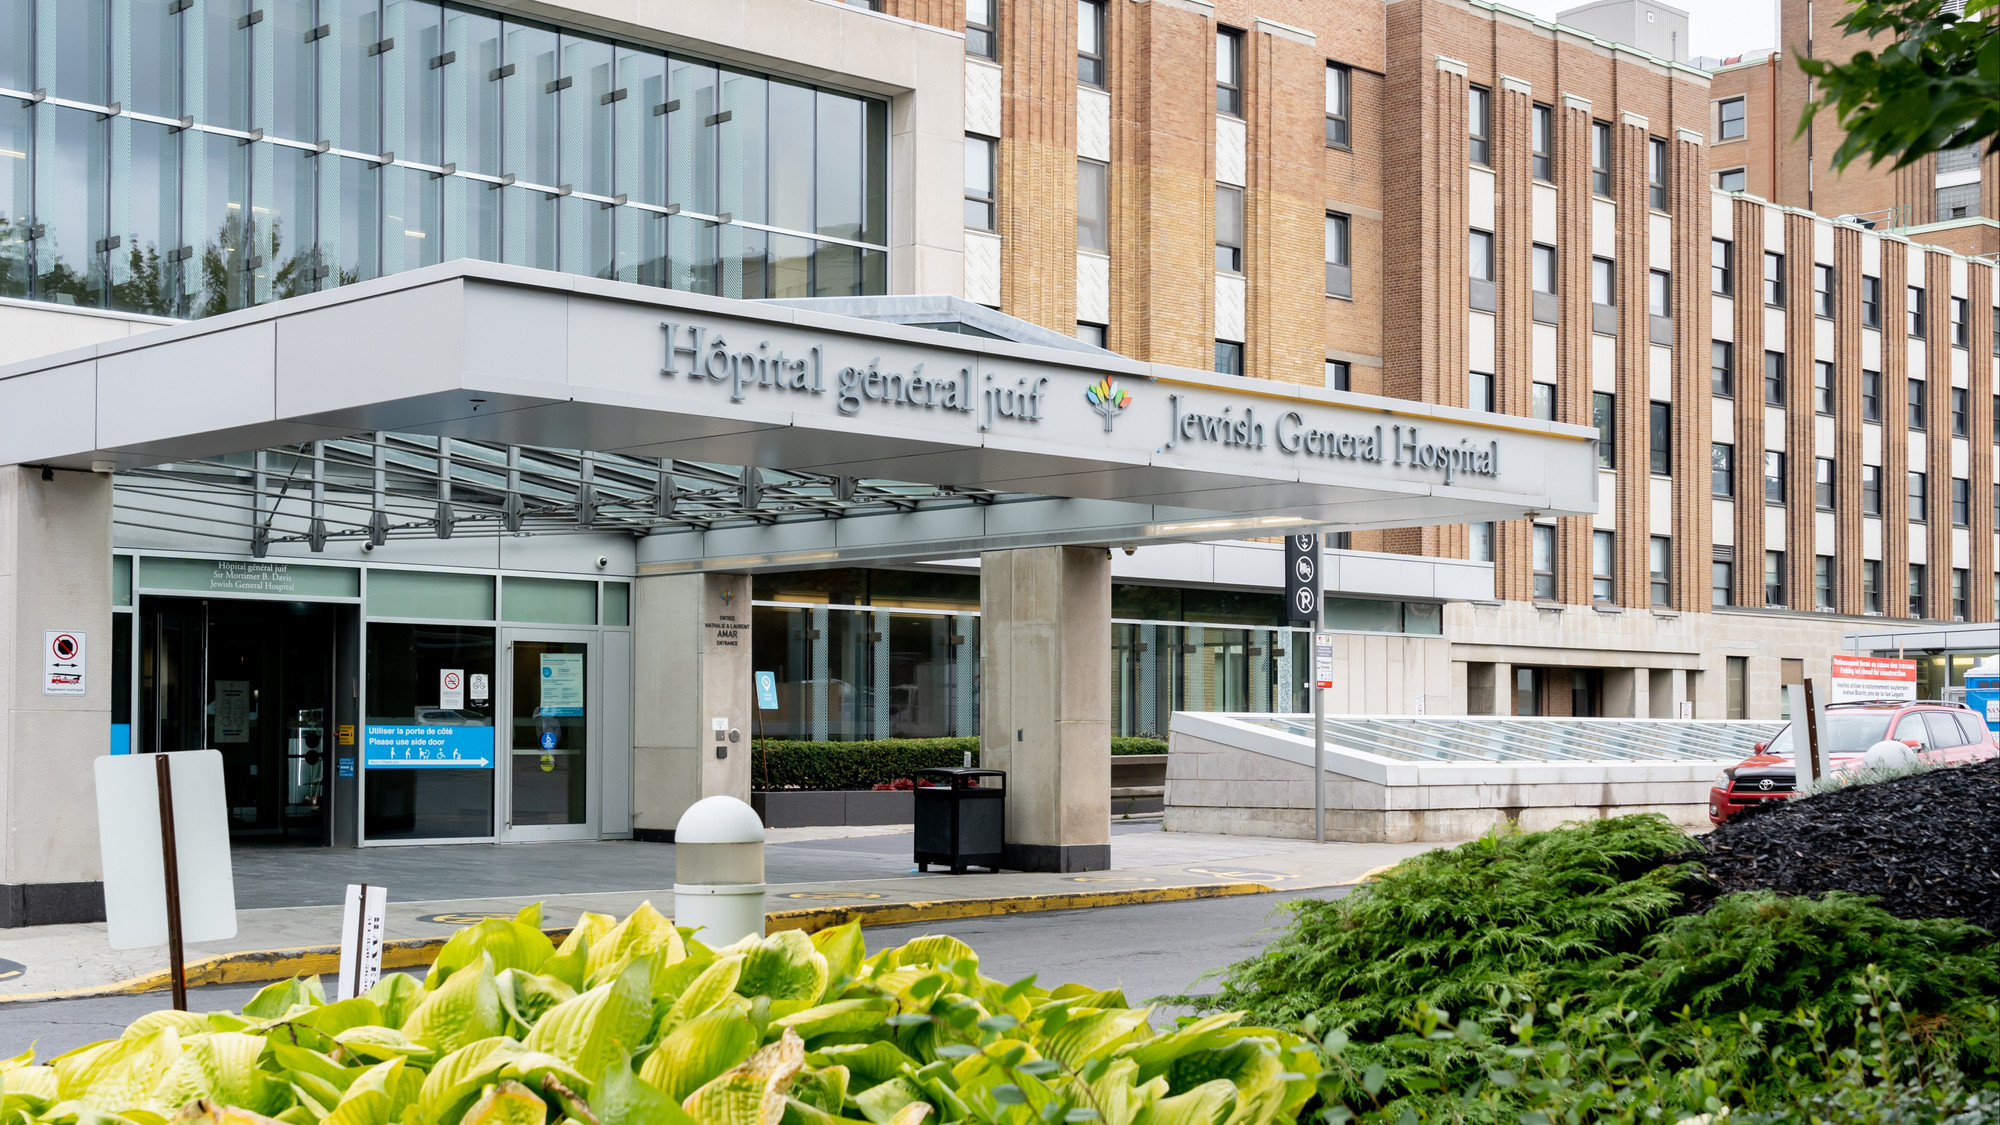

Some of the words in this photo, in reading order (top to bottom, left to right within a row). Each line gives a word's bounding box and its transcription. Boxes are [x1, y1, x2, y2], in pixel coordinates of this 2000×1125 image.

[659, 320, 827, 401] Hôpital
[838, 356, 976, 414] général
[980, 372, 1051, 431] juif
[1166, 393, 1268, 448] Jewish
[1276, 410, 1387, 463] General
[1393, 423, 1502, 486] Hospital
[218, 561, 246, 572] Hôpital
[247, 563, 273, 573] général
[274, 564, 288, 573] juif
[213, 570, 224, 579] Sir
[225, 571, 260, 580] Mortimer
[262, 572, 270, 580] B.
[272, 573, 292, 582] Davis
[209, 579, 233, 589] Jewish
[235, 580, 263, 590] General
[264, 581, 295, 592] Hospital
[717, 630, 738, 638] AMAR
[1840, 666, 1854, 675] Parking
[1880, 669, 1906, 677] construction
[405, 728, 425, 736] porte
